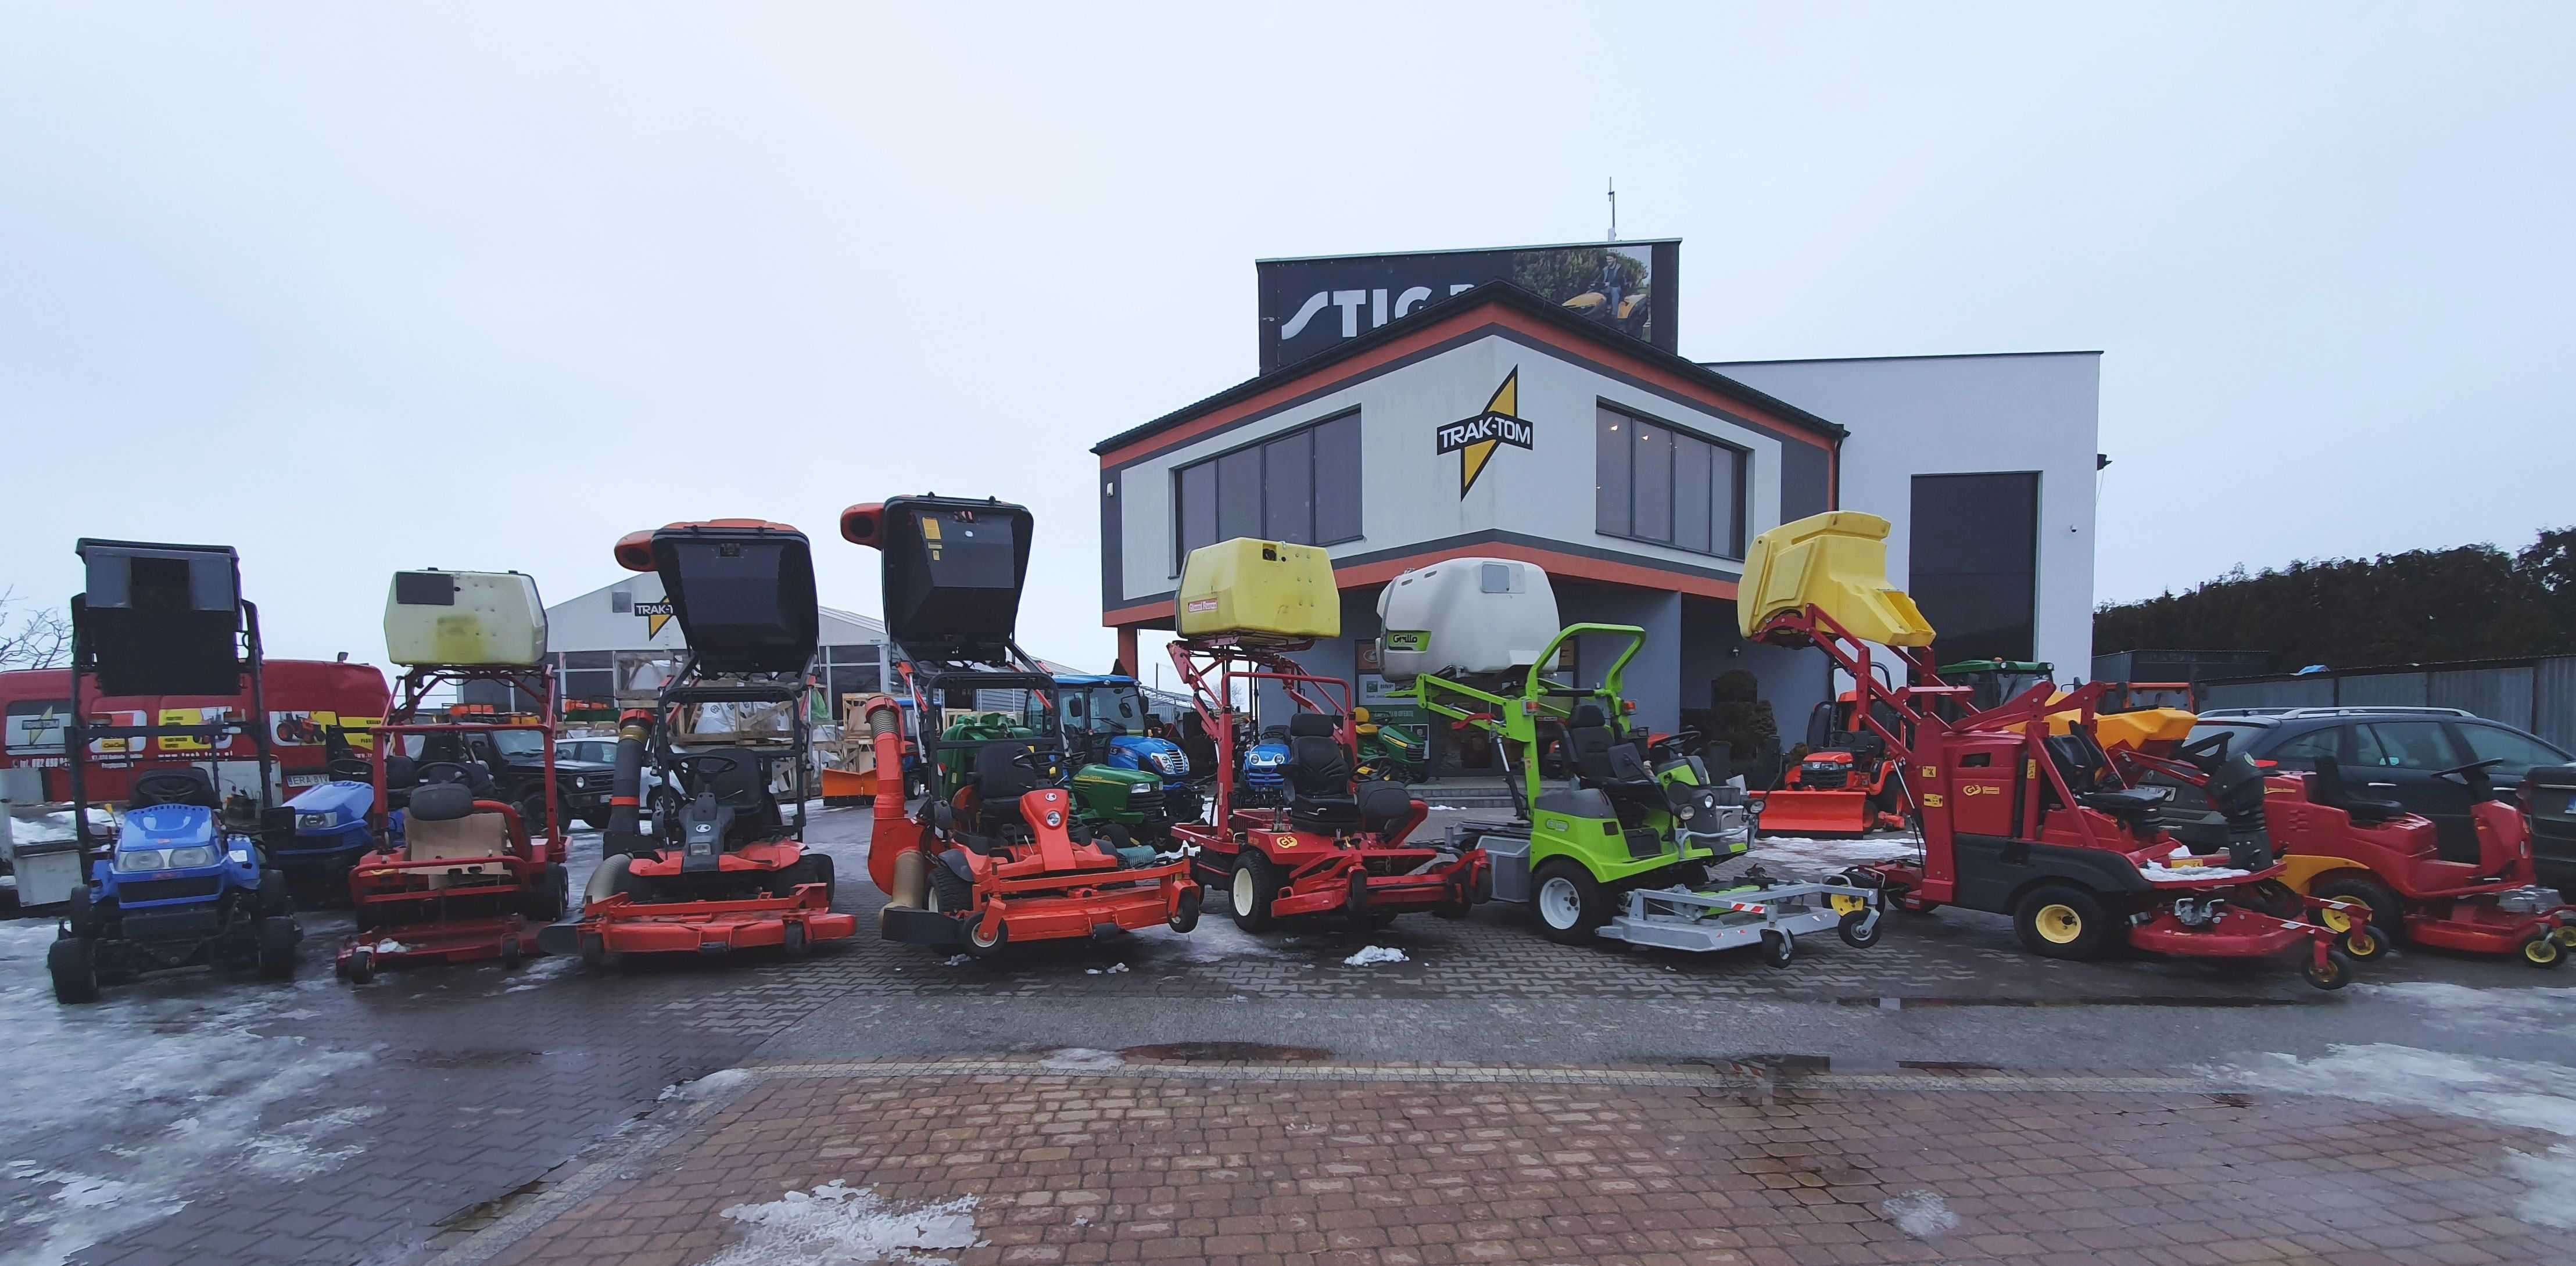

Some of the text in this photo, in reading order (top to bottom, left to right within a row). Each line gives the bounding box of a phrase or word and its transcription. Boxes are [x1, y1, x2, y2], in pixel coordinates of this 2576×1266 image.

[1281, 284, 1475, 340] STIG
[1439, 416, 1531, 449] TRAK-TOM
[1393, 634, 1418, 644] Grillo
[293, 776, 311, 784] ERA
